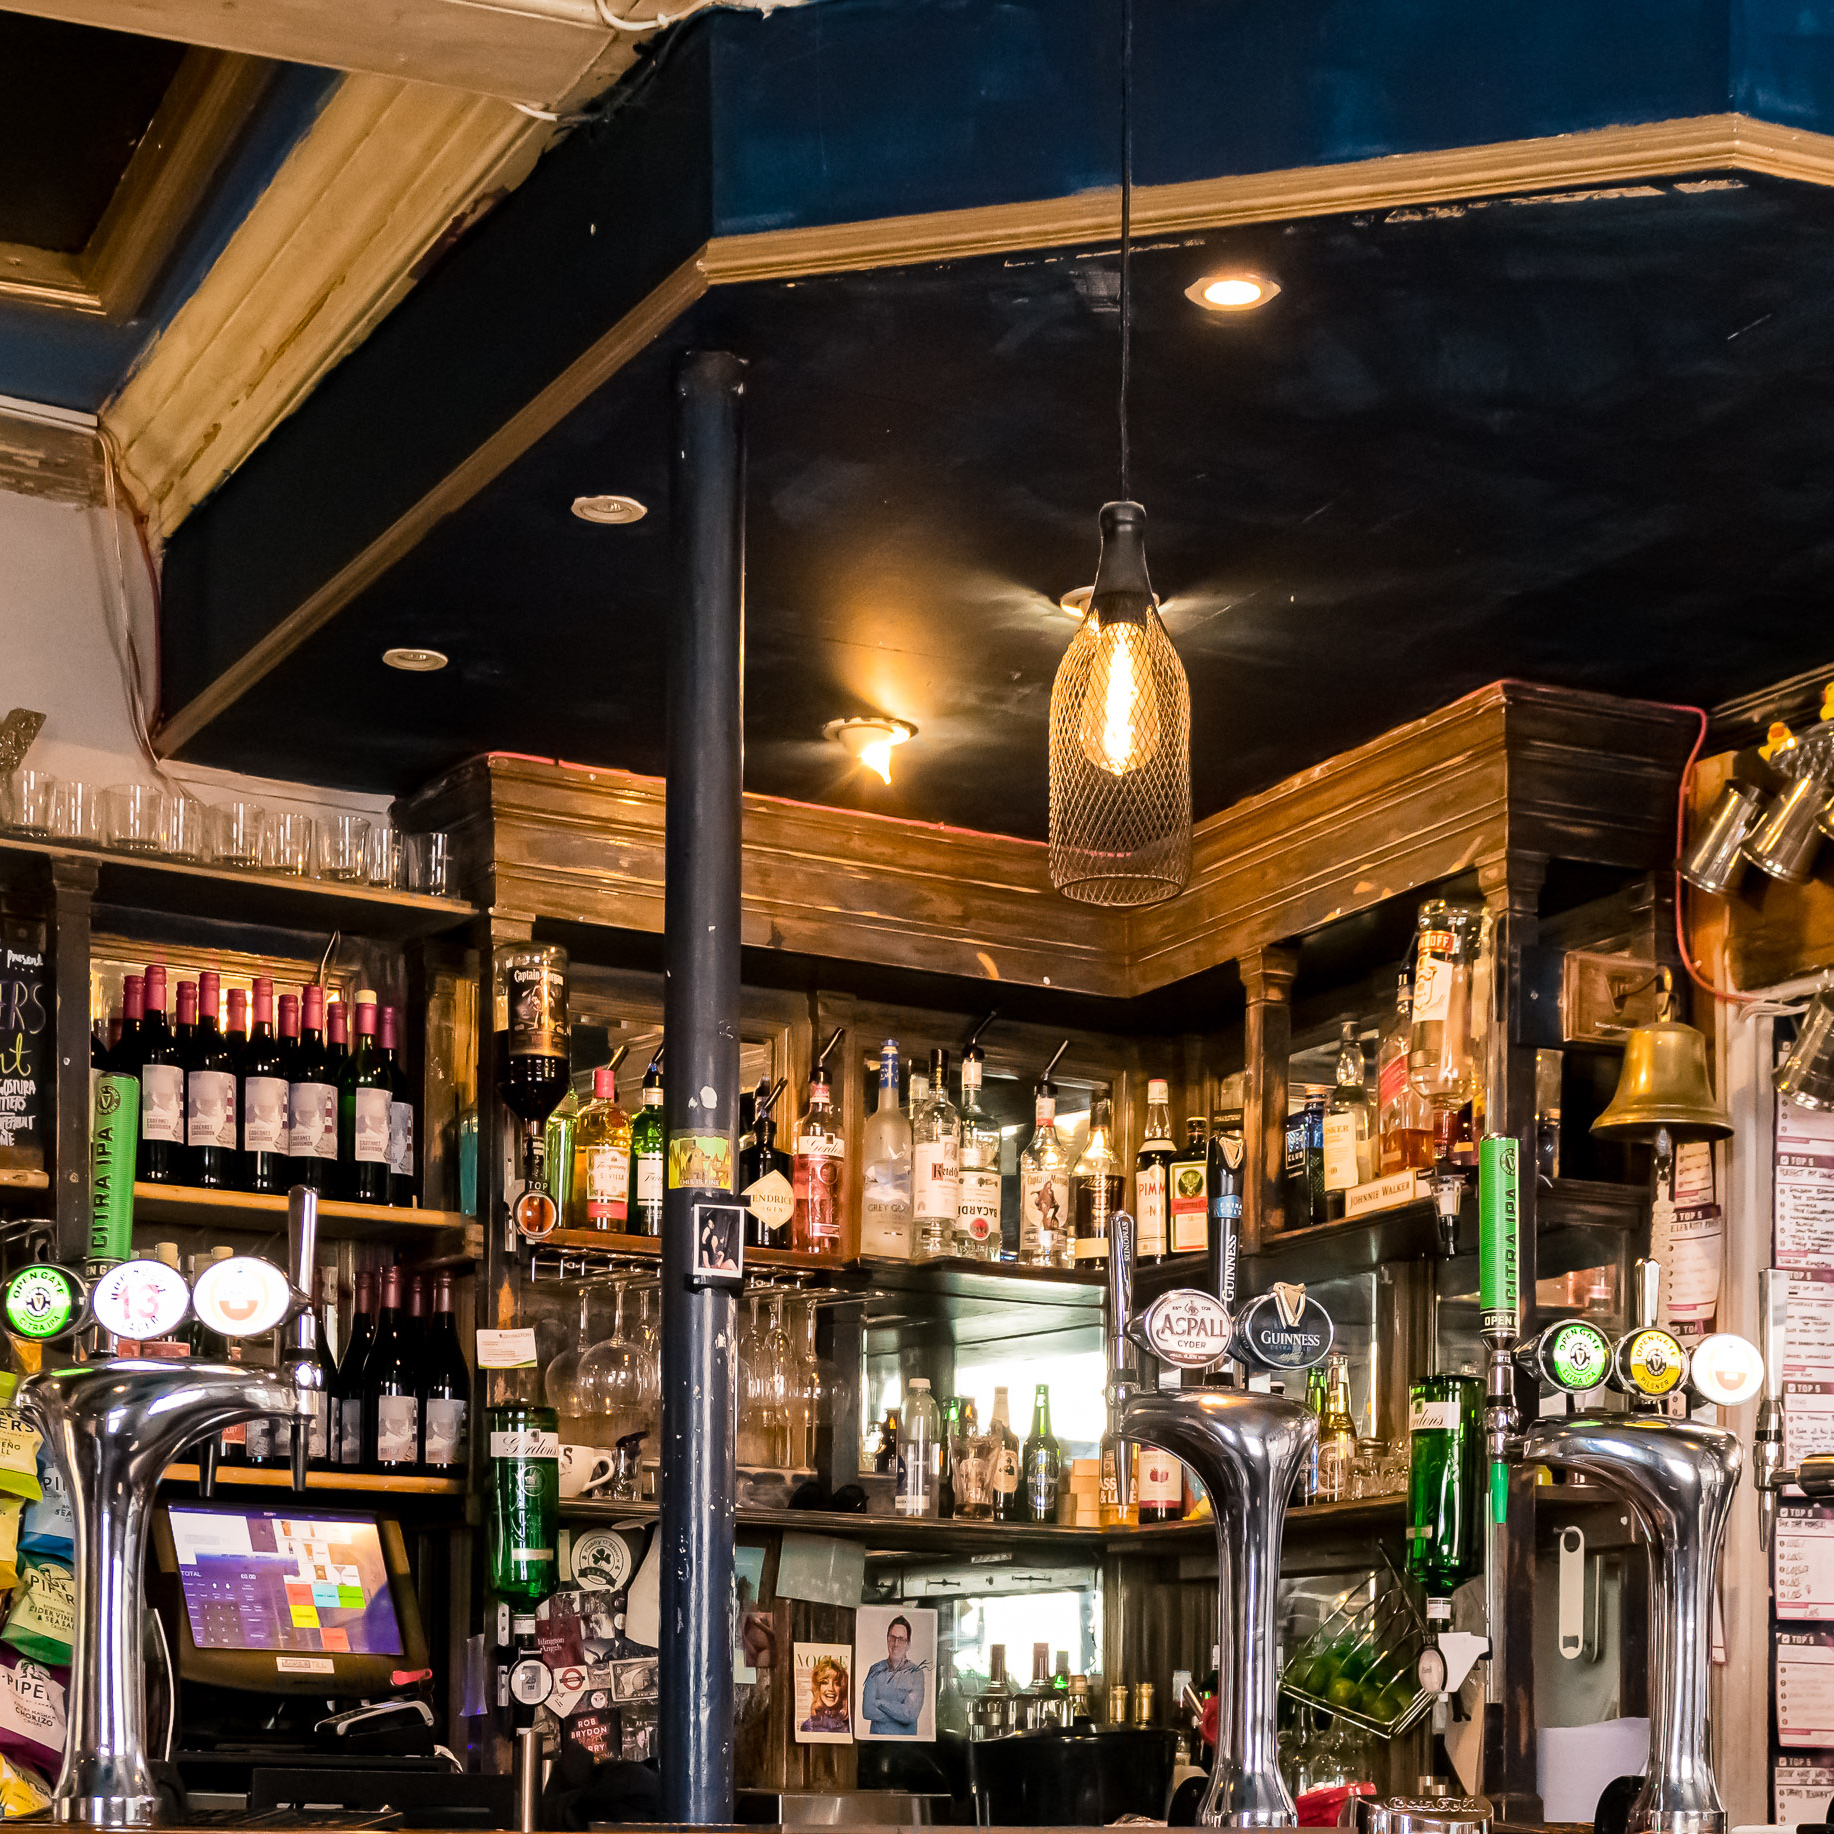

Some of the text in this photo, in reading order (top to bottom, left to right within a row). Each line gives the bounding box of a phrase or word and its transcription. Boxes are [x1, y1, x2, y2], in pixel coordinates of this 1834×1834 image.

[1287, 1151, 1303, 1162] CLUB
[91, 1125, 113, 1249] IPA CITRA
[528, 1181, 548, 1190] TOP
[679, 1178, 693, 1186] THIS
[1350, 1180, 1410, 1209] JOHNNIE WALKER
[868, 1203, 888, 1213] GREY
[1506, 1188, 1516, 1227] IPA
[1679, 1211, 1696, 1220] TOP
[1122, 1221, 1130, 1262] SYMONDS
[1222, 1234, 1237, 1302] GUINNESS
[12, 1271, 65, 1299] OPEN GATE
[18, 1315, 62, 1331] CITRA IPA
[1156, 1313, 1227, 1342] ASPALL
[1484, 1315, 1512, 1326] OPEN
[1177, 1340, 1206, 1349] CYDER
[1261, 1330, 1320, 1347] GUINNESS
[1560, 1328, 1600, 1352] OPEN GATE
[1636, 1334, 1676, 1359] OPEN GATE
[1562, 1369, 1597, 1384] CITRA IPA
[1640, 1376, 1669, 1390] PILSNER
[15, 1706, 54, 1727] CHORIZO
[577, 1718, 597, 1728] ROB
[570, 1725, 607, 1738] BRYDON
